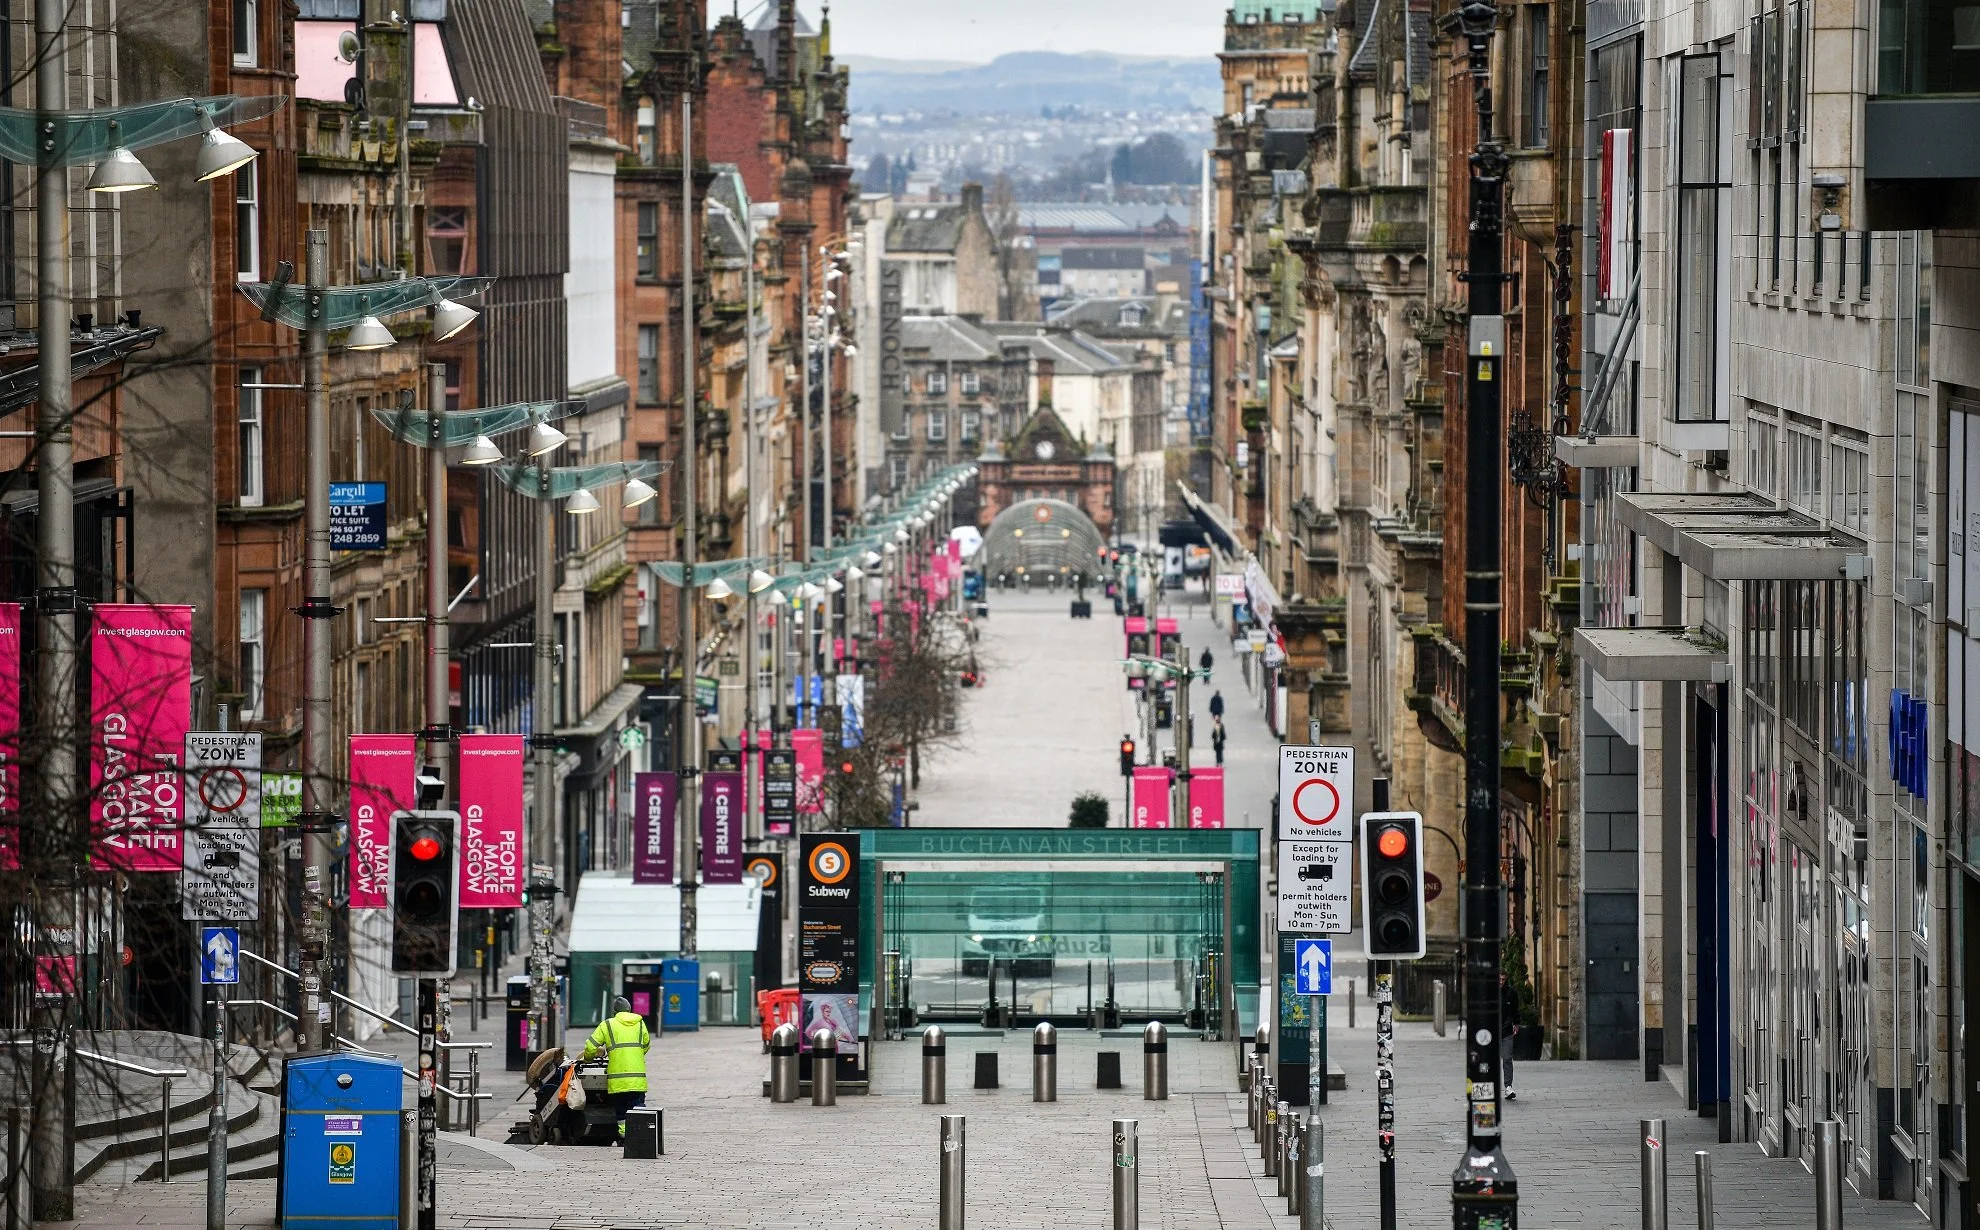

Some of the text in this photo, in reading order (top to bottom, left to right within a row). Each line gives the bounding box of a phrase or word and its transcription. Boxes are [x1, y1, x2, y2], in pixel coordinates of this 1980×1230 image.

[330, 506, 365, 516] O LET
[334, 534, 380, 543] 248 2859
[97, 627, 186, 638] investglasgow.com
[191, 737, 256, 746] PEDESTRIAN
[200, 748, 246, 760] ZONE
[354, 748, 411, 756] investglasgow.com
[464, 748, 520, 756] investglasgow.com
[1286, 750, 1348, 758] PEDESTRIAN
[1294, 762, 1338, 774] ZONE
[128, 774, 152, 848] MAKE
[212, 814, 249, 824] vehicles
[648, 794, 661, 855] CENTRE
[716, 794, 728, 855] CENTRE
[1290, 828, 1342, 836] No vehicles
[234, 842, 246, 850] by
[358, 804, 374, 894] GLASGOW
[467, 804, 482, 894] GLASGOW
[921, 836, 1188, 853] BUCHANAN STREET
[1292, 845, 1338, 854] Except for
[500, 830, 516, 894] PEOPLE
[826, 856, 834, 870] S
[1292, 854, 1338, 864] loading by
[374, 844, 389, 894] MAKE
[483, 844, 498, 894] MAKE
[212, 871, 230, 879] and
[188, 880, 254, 889] permit holders
[204, 890, 238, 898] outwith
[808, 886, 850, 900] Subway
[1282, 892, 1348, 901] permit holders
[192, 908, 204, 916] 10
[1294, 911, 1311, 920] Mon
[1320, 912, 1338, 920] Sun
[1288, 920, 1298, 928] 10
[1326, 922, 1340, 931] pm
